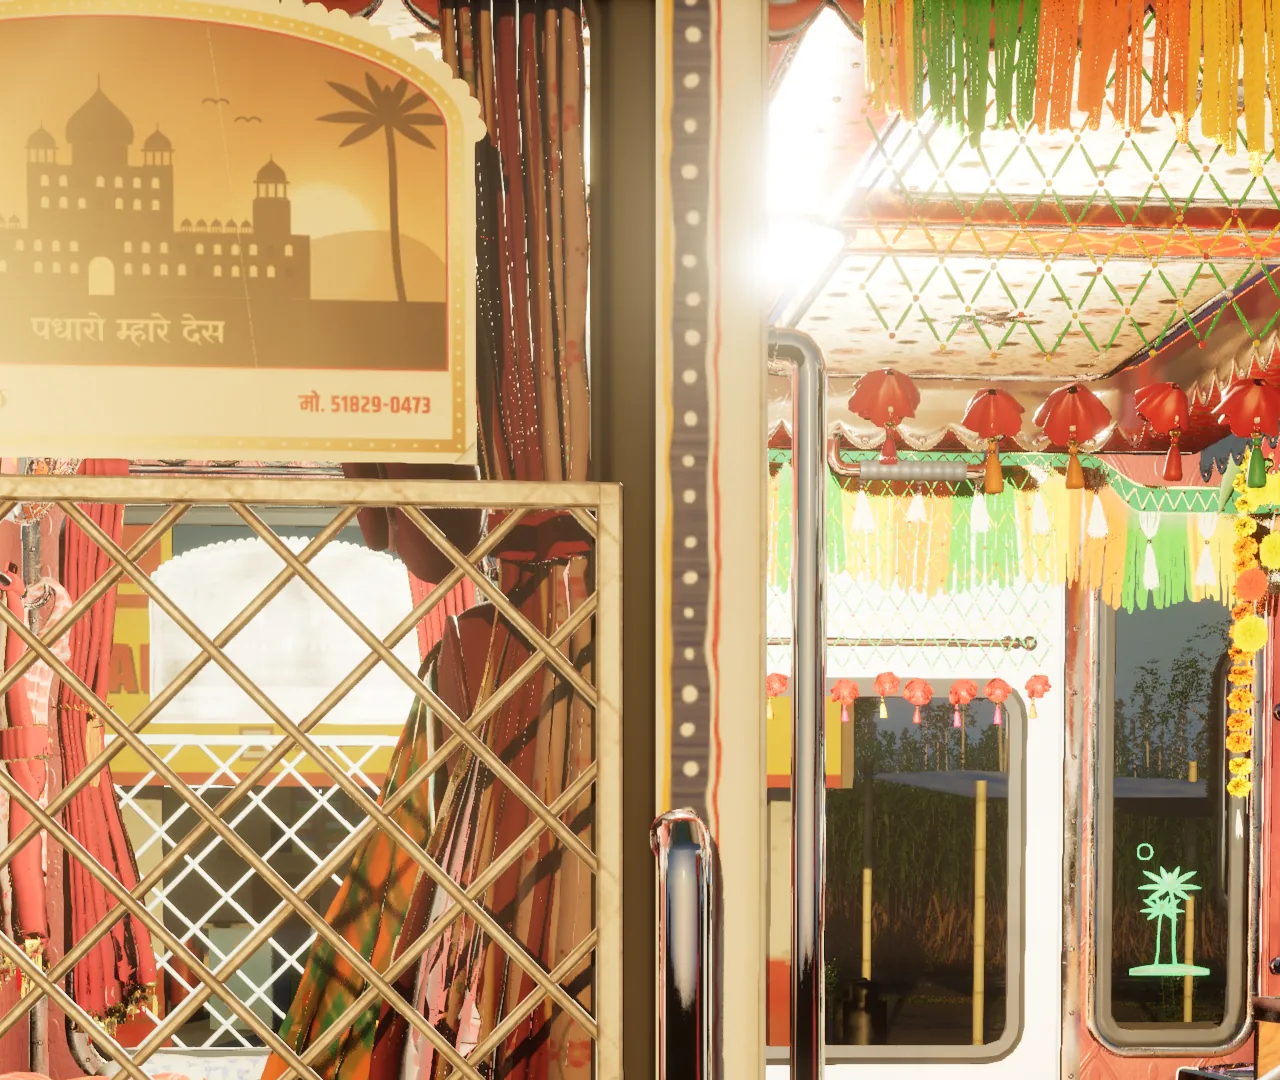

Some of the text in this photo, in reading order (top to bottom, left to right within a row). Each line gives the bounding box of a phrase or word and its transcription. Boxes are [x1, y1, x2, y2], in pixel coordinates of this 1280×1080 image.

[30, 311, 225, 347] पधारो म्हारे देस
[298, 390, 431, 414] मो. 51829-0473
